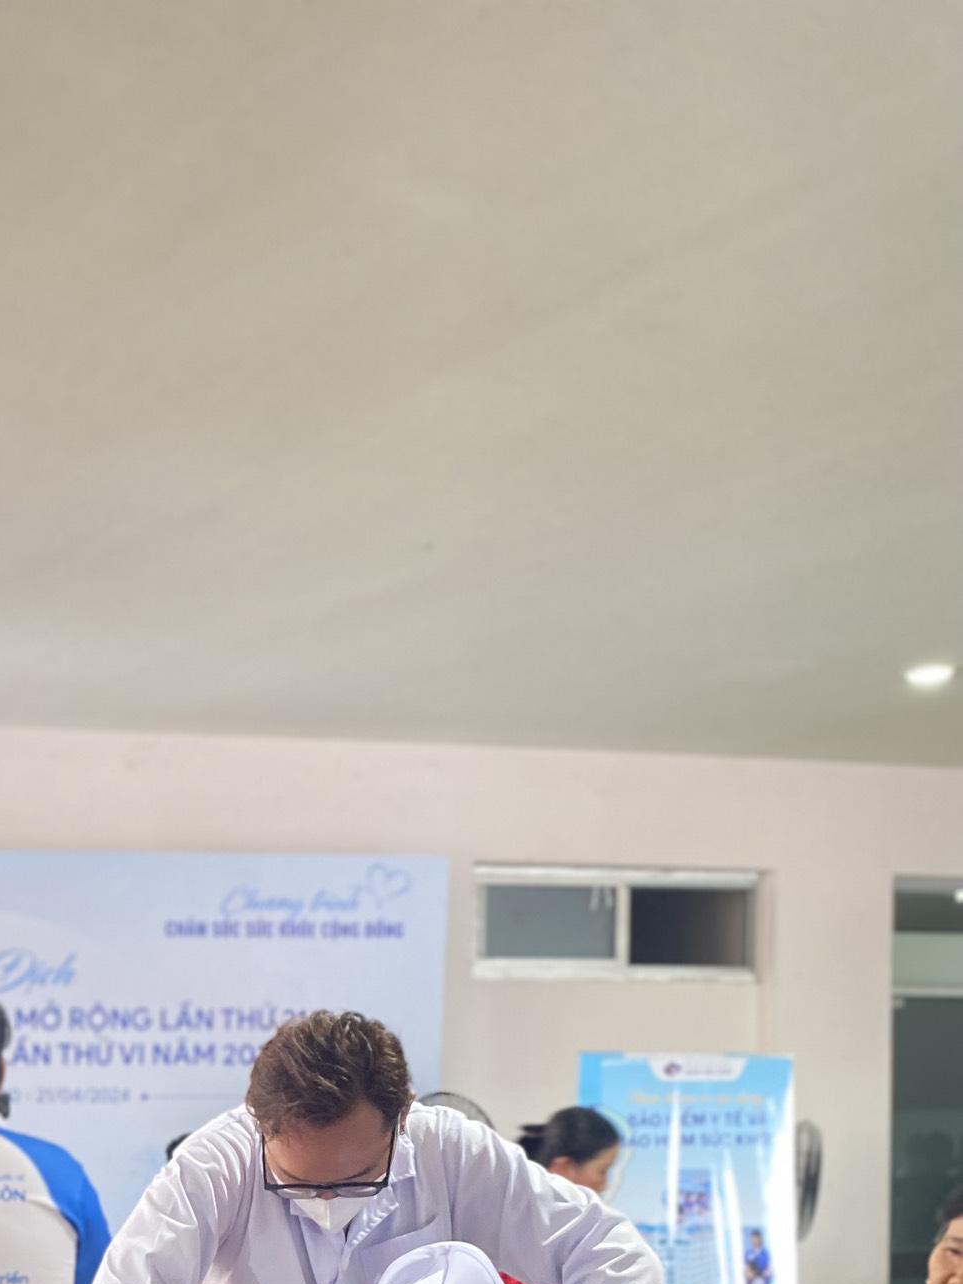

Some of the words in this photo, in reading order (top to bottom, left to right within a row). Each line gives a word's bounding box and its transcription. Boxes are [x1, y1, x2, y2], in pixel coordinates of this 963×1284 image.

[14, 1001, 62, 1031] MỞ
[69, 1001, 152, 1033] RỘNG
[159, 1000, 215, 1031] LẦN
[7, 1035, 51, 1066] ẦN
[58, 1037, 115, 1066] THỨ
[120, 1042, 147, 1066] VI
[152, 1037, 216, 1066] NĂM
